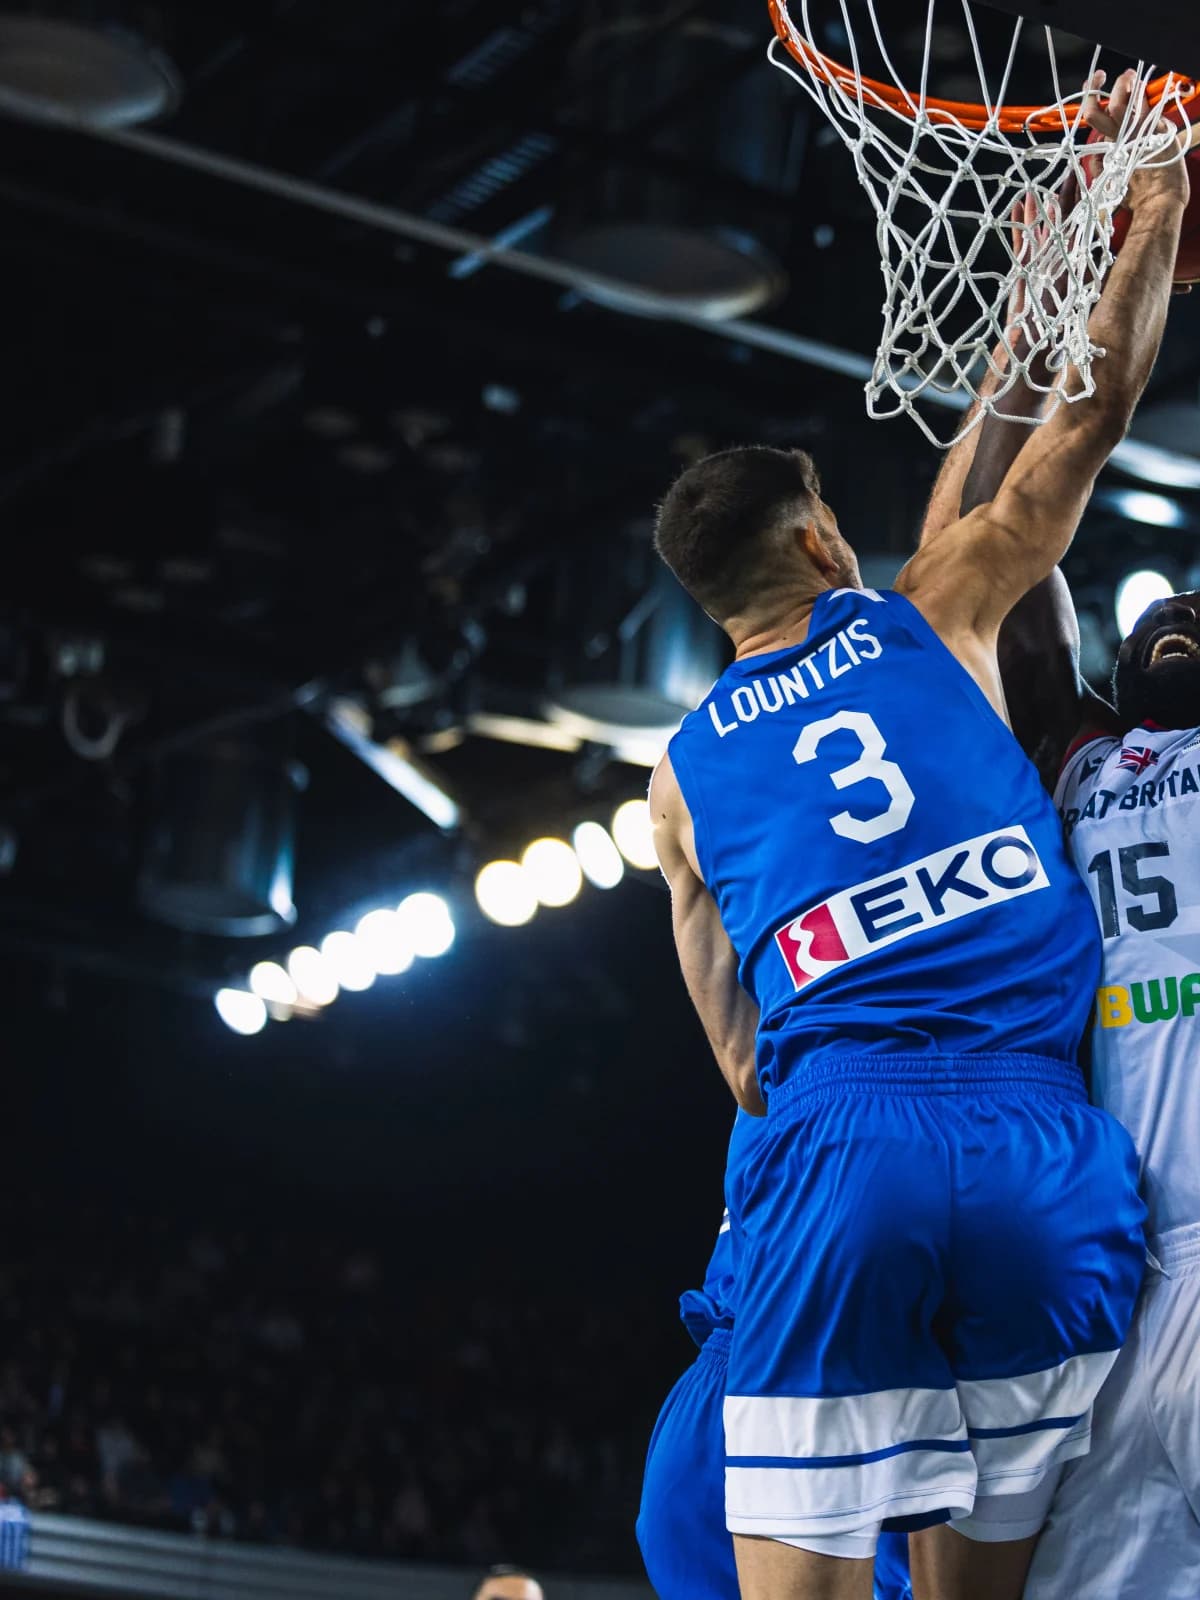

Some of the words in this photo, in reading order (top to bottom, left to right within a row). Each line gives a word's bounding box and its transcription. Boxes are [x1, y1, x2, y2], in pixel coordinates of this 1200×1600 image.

[708, 618, 884, 738] LOUNTZIS
[791, 710, 916, 844] 3
[849, 835, 1038, 943] EKO
[1088, 840, 1179, 939] 15
